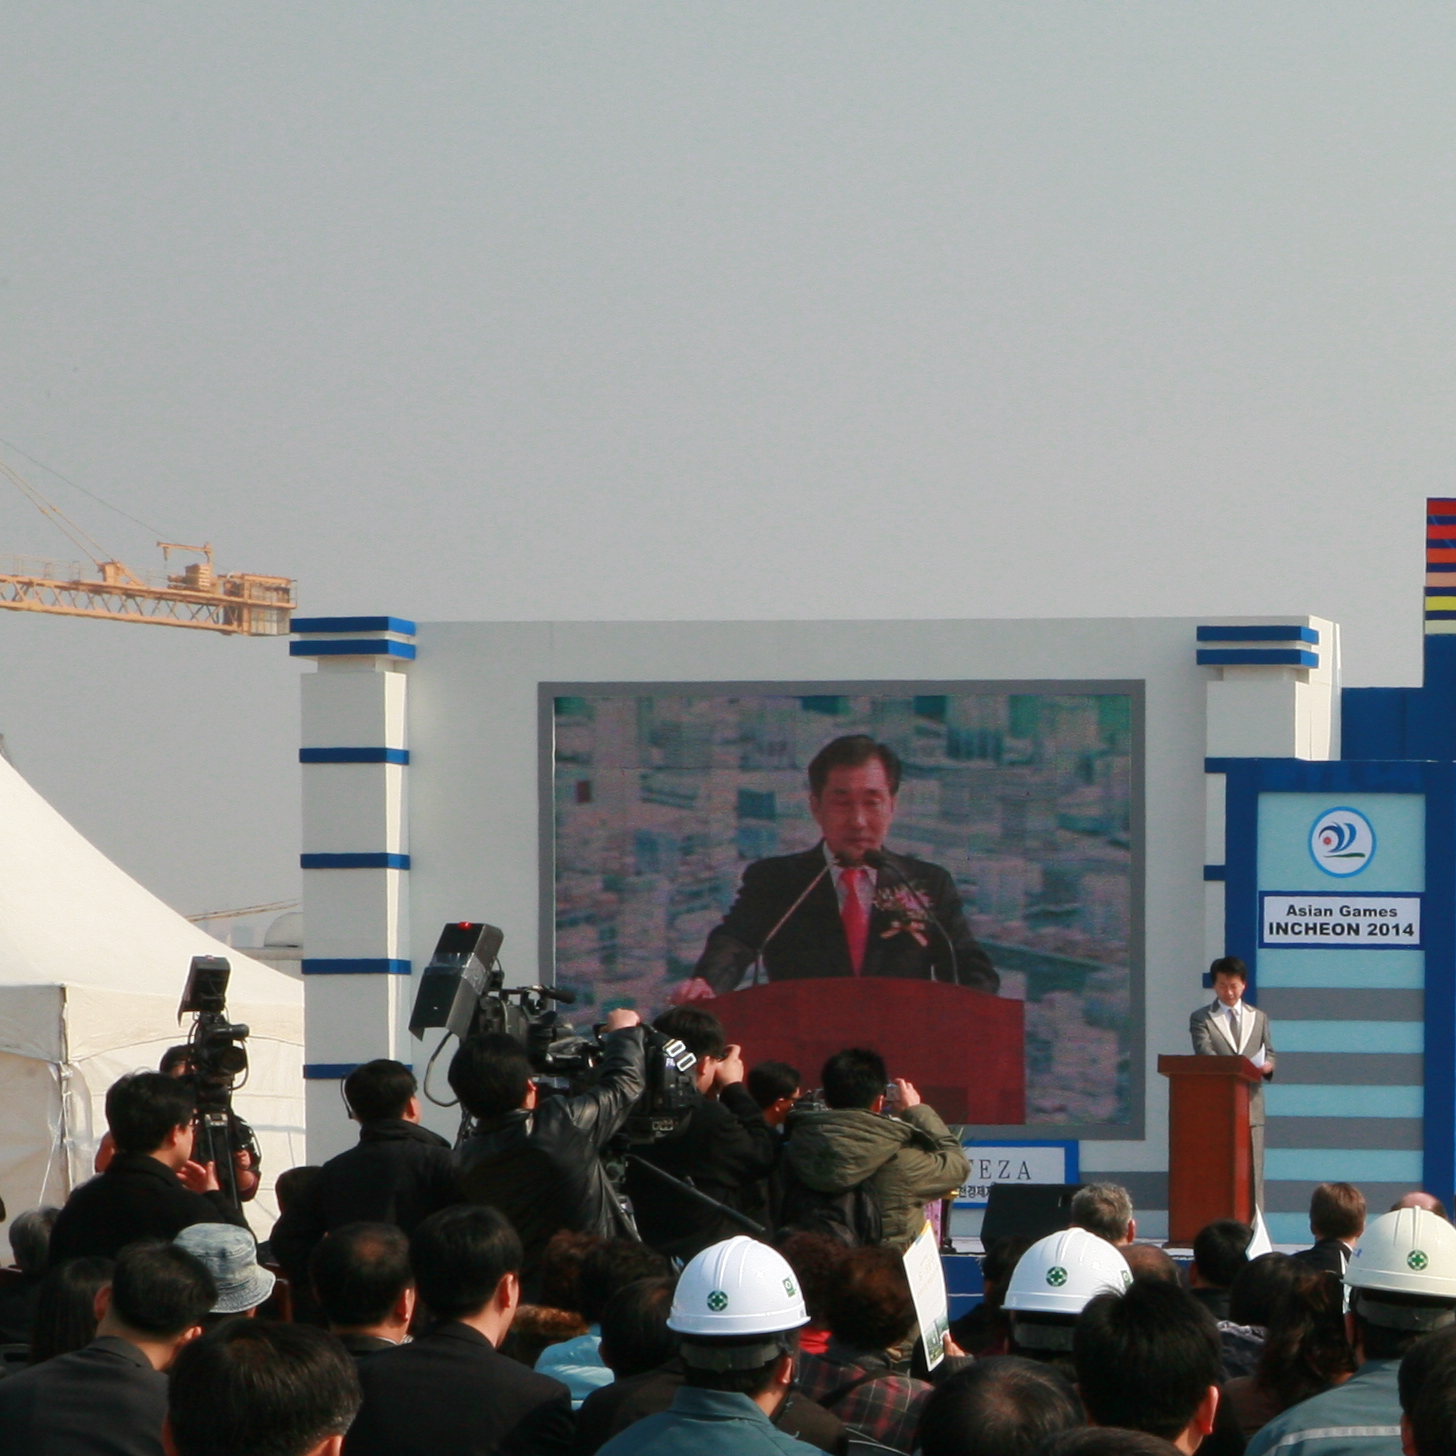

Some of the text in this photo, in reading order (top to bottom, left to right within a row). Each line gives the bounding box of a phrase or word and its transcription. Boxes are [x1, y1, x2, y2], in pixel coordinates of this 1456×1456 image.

[1286, 905, 1398, 918] Asian Games
[1268, 922, 1415, 937] INCHEON 2014
[967, 1158, 1032, 1180] EZA
